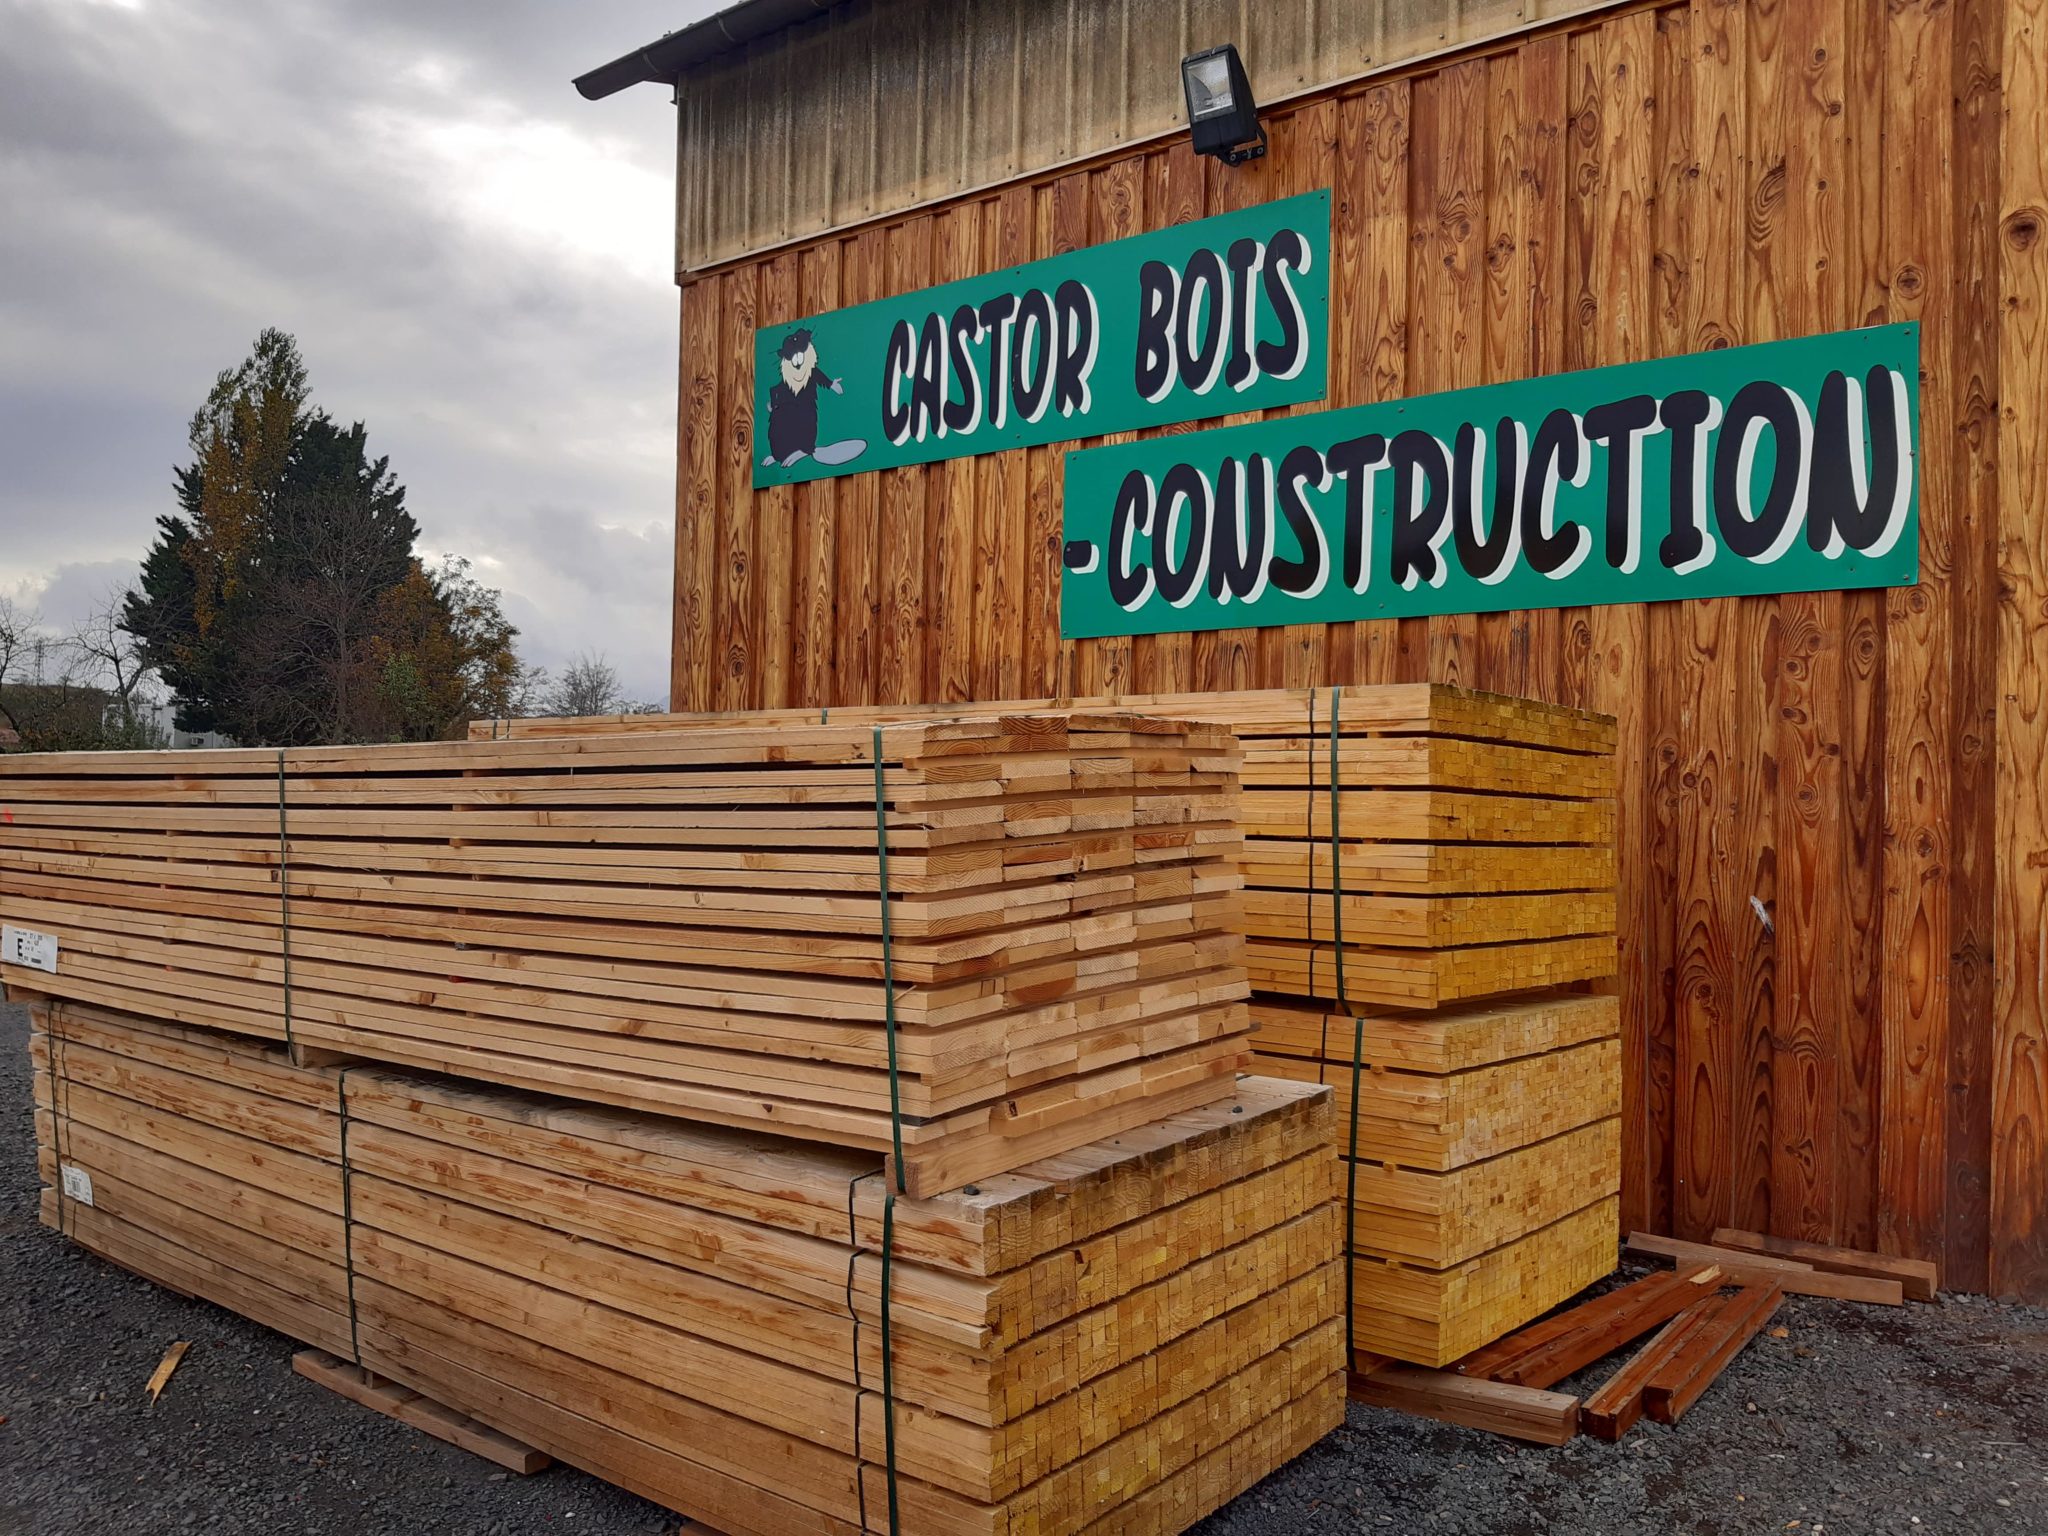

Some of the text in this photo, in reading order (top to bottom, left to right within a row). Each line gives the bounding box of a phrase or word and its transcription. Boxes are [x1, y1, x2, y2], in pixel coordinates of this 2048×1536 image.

[882, 229, 1311, 446] CASTOR BOIS
[17, 938, 23, 957] E
